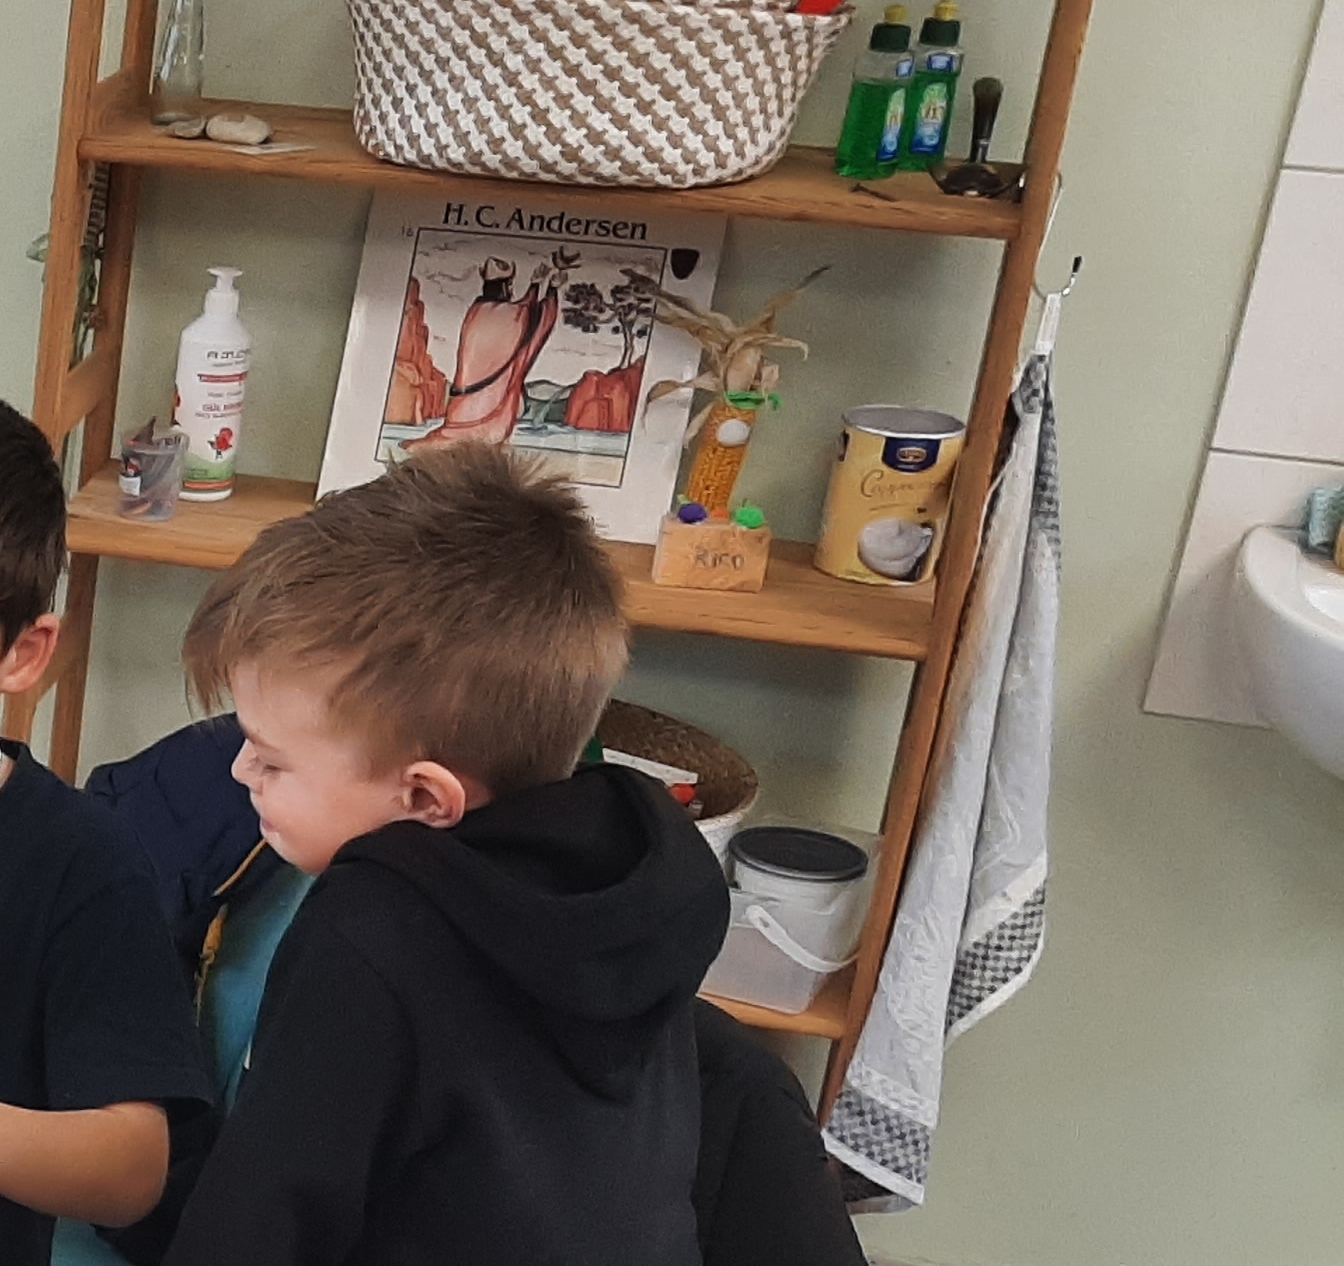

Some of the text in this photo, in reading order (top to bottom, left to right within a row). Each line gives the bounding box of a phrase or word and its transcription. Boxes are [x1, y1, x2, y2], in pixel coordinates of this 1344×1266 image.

[443, 202, 648, 241] H. C. Andersen
